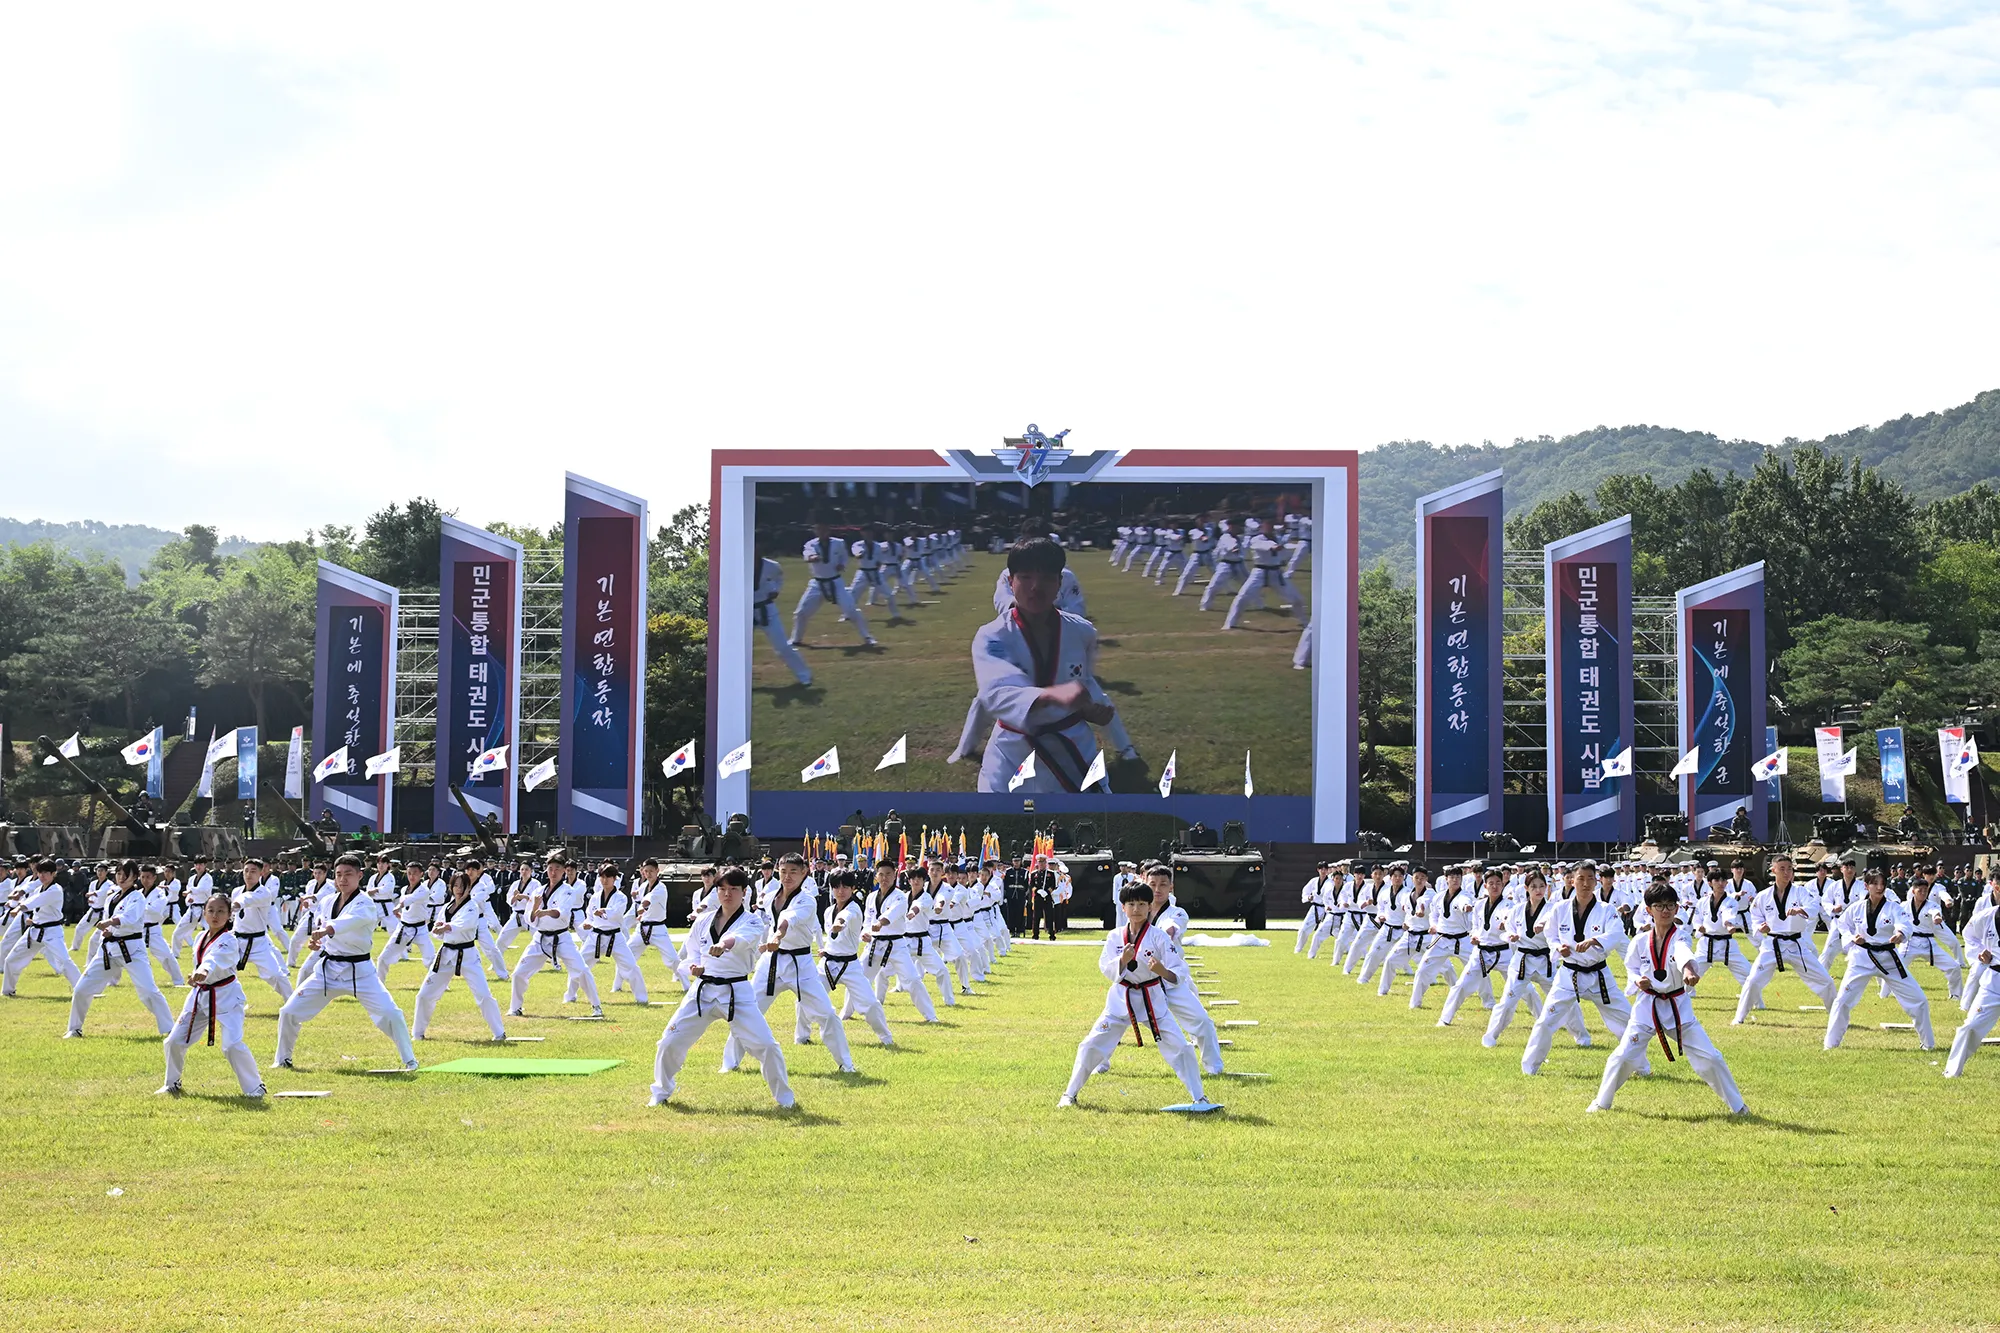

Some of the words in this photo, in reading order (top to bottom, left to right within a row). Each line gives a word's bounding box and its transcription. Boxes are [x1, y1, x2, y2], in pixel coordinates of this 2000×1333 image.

[470, 565, 491, 656] 민군통합
[1578, 566, 1600, 660] 민군통합
[346, 615, 363, 673] 기본에
[1713, 619, 1730, 680] 기본에
[344, 684, 361, 747] 충실한
[467, 662, 489, 728] 태권도
[1579, 666, 1601, 735] 태권도
[1713, 690, 1731, 755] 충실한
[1580, 742, 1601, 789] 시범
[1715, 766, 1731, 785] 군
